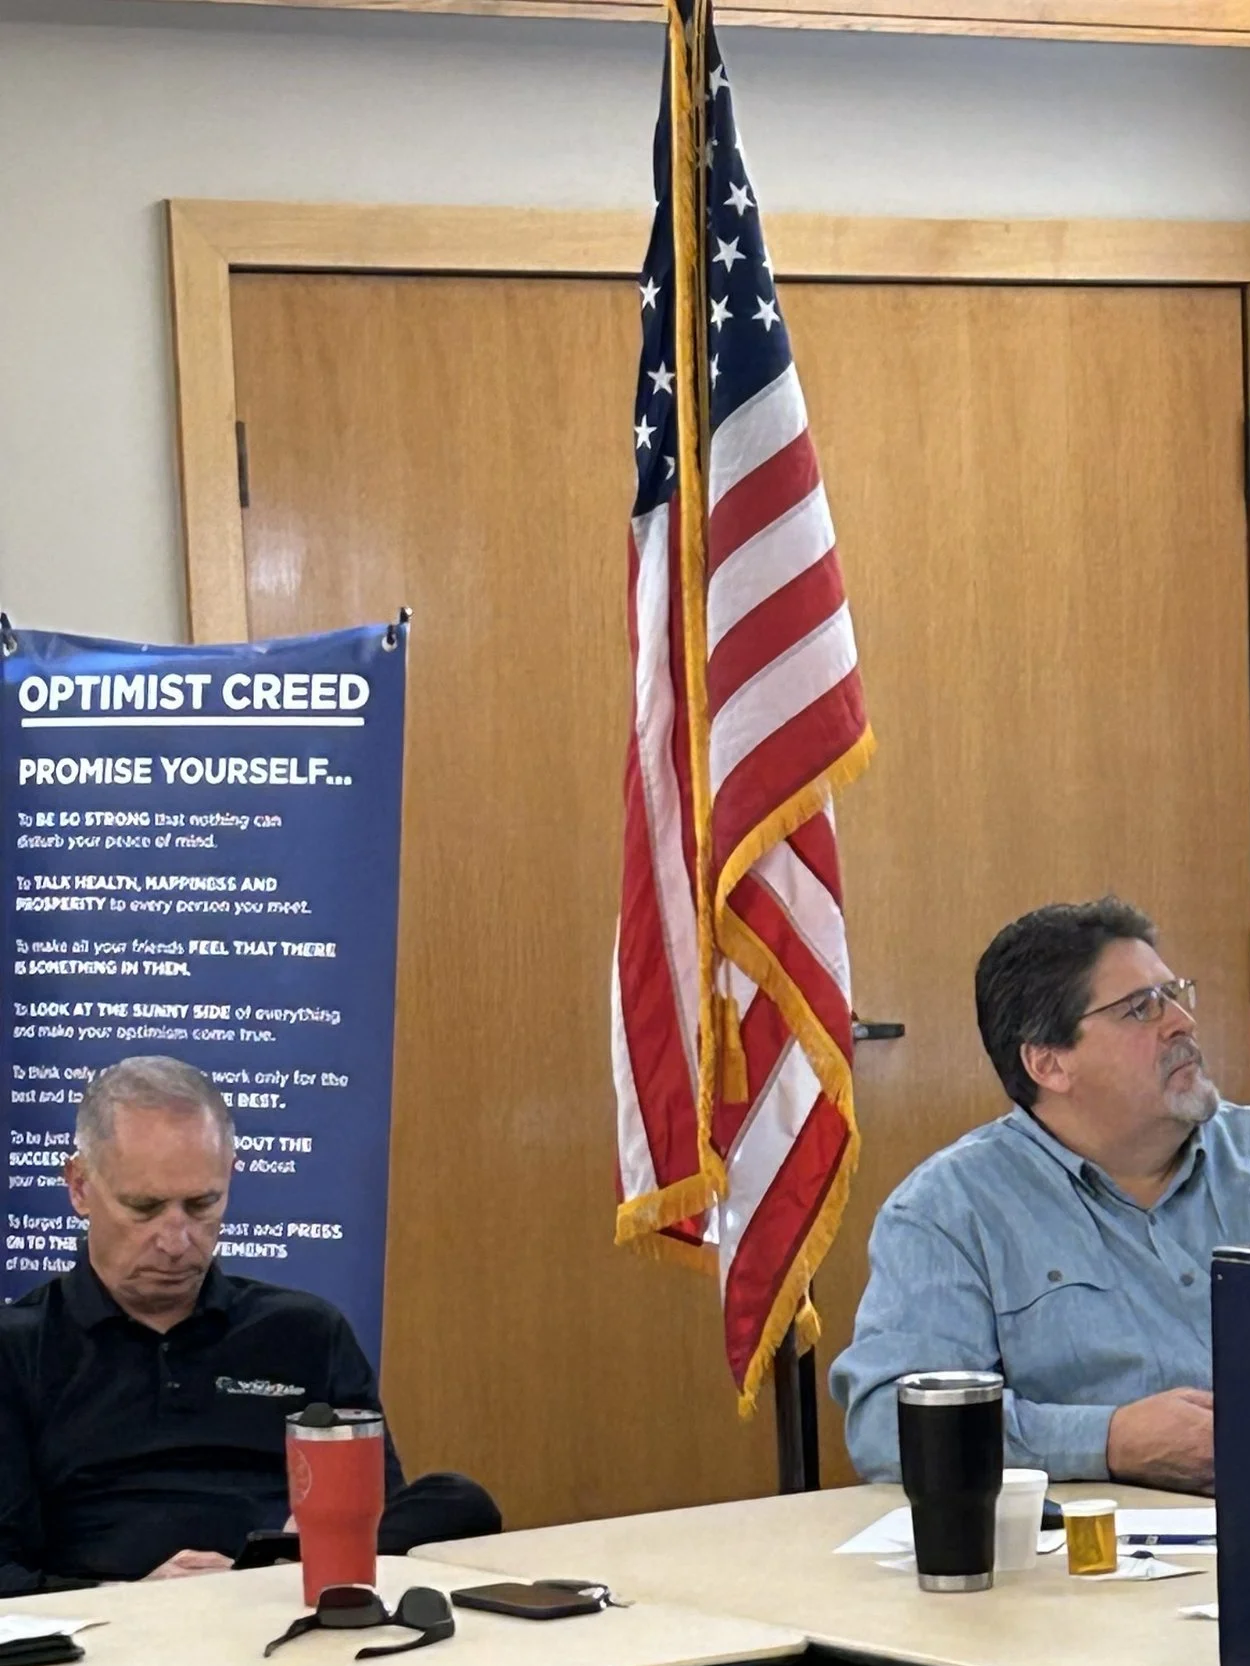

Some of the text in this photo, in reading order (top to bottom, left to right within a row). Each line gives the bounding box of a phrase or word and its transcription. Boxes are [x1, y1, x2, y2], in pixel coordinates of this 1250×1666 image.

[18, 673, 370, 712] OPTIMIST CREED
[19, 757, 352, 786] PROMISE YOURSELF...
[18, 812, 282, 830] To BE SO STRONG that nothing can
[17, 833, 218, 850] disturb your peace of mind.
[16, 876, 277, 892] To TALK HEALTH, HAPPINESS AND
[15, 897, 106, 911] PROSPERITY
[110, 898, 126, 911] to
[130, 901, 172, 914] every
[176, 900, 230, 915] person
[235, 902, 263, 915] you
[16, 939, 336, 957] To make all your friends FEEL THAT THERE
[14, 960, 191, 976] IS SOMETHING IN THEM.
[14, 1003, 341, 1025] To LOOK AT THE SUNNY SIDE of everything
[13, 1024, 276, 1042] and make your optimism come true.
[13, 1065, 25, 1079] To
[28, 1065, 60, 1079] think
[64, 1066, 96, 1083] only
[212, 1069, 249, 1084] work
[255, 1070, 289, 1088] only
[293, 1070, 316, 1085] for
[321, 1072, 349, 1087] the
[11, 1090, 36, 1103] best
[39, 1089, 64, 1103] and
[238, 1093, 286, 1108] BEST.
[11, 1130, 24, 1144] To
[26, 1131, 41, 1144] be
[44, 1131, 70, 1147] just
[279, 1137, 312, 1152] THE
[9, 1176, 33, 1189] your
[8, 1214, 20, 1229] To
[23, 1214, 62, 1231] forget
[253, 1222, 283, 1236] and
[287, 1223, 343, 1239] PRESS
[6, 1235, 24, 1250] ON
[27, 1235, 45, 1250] TO
[49, 1235, 77, 1251] THE
[6, 1257, 18, 1270] of
